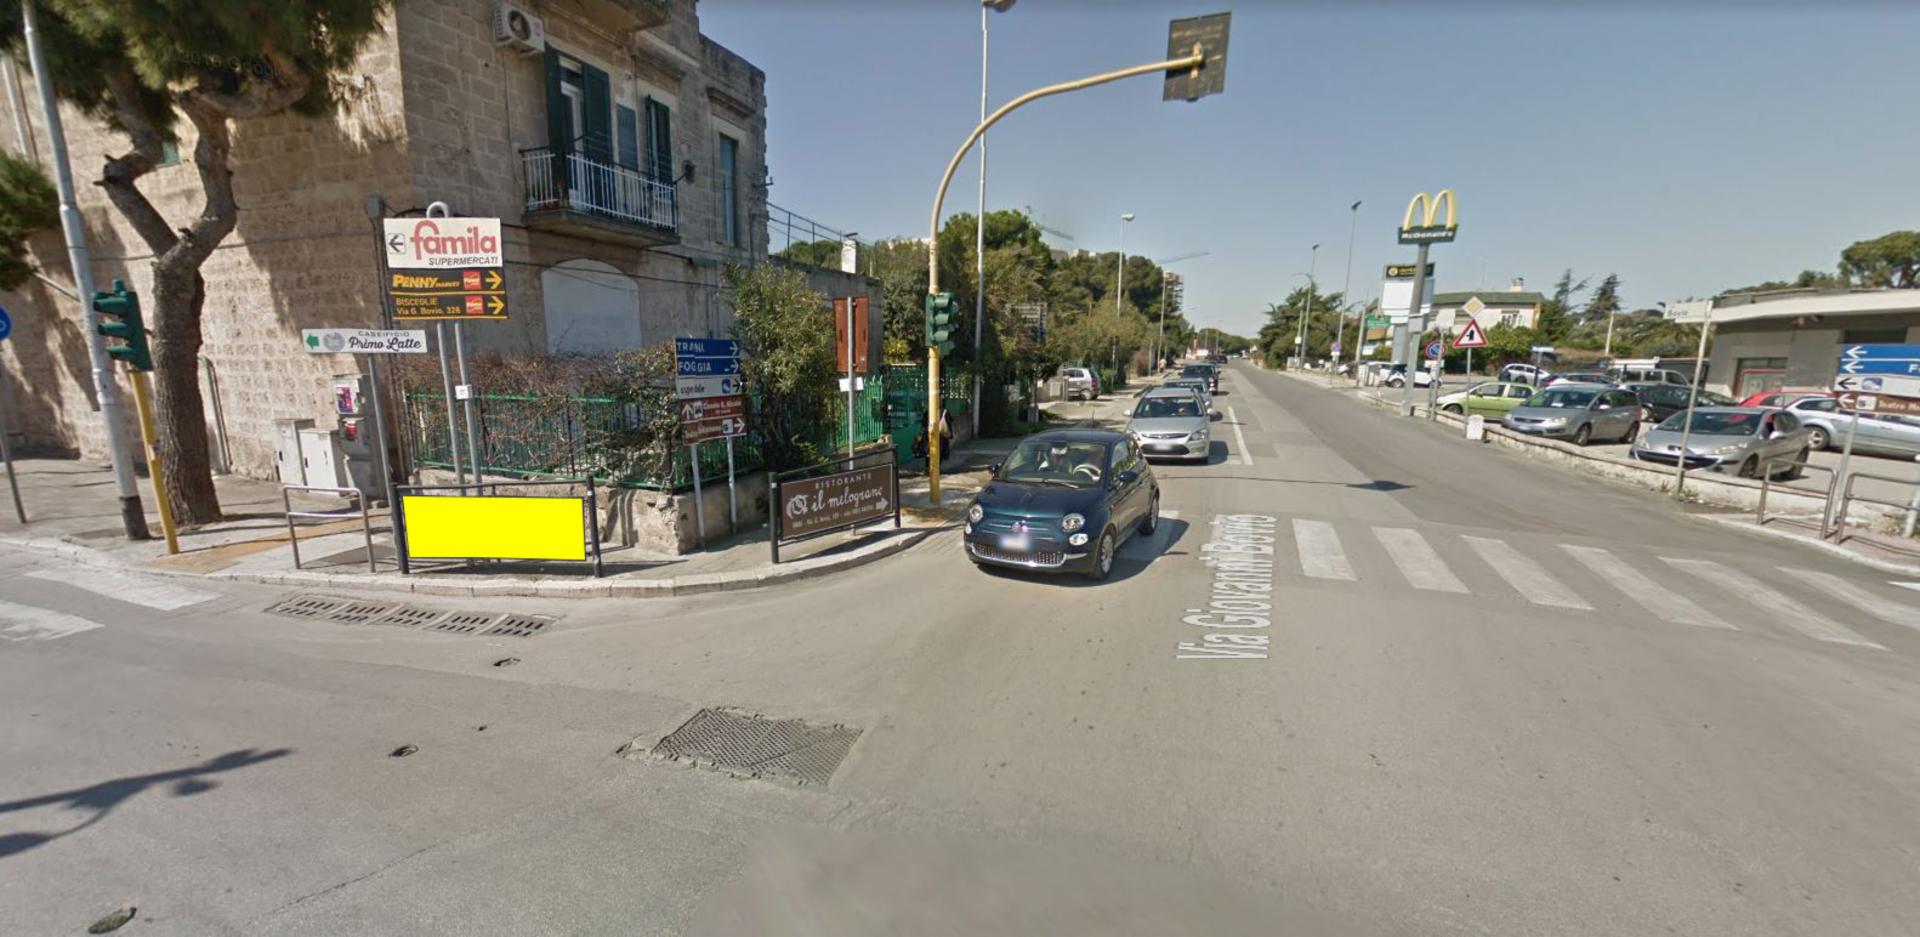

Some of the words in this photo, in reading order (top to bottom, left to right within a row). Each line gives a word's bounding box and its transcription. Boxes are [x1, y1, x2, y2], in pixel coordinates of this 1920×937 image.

[410, 220, 497, 260] famila
[428, 256, 499, 267] SUPERMERCATI
[392, 274, 438, 289] PENNY
[358, 330, 410, 338] CASEIFICIO
[348, 336, 384, 349] Primo
[386, 337, 421, 351] Latte
[678, 361, 713, 373] FOGGIA
[815, 472, 873, 490] RISTORANTE
[811, 489, 826, 513] il
[828, 486, 884, 508] melograno
